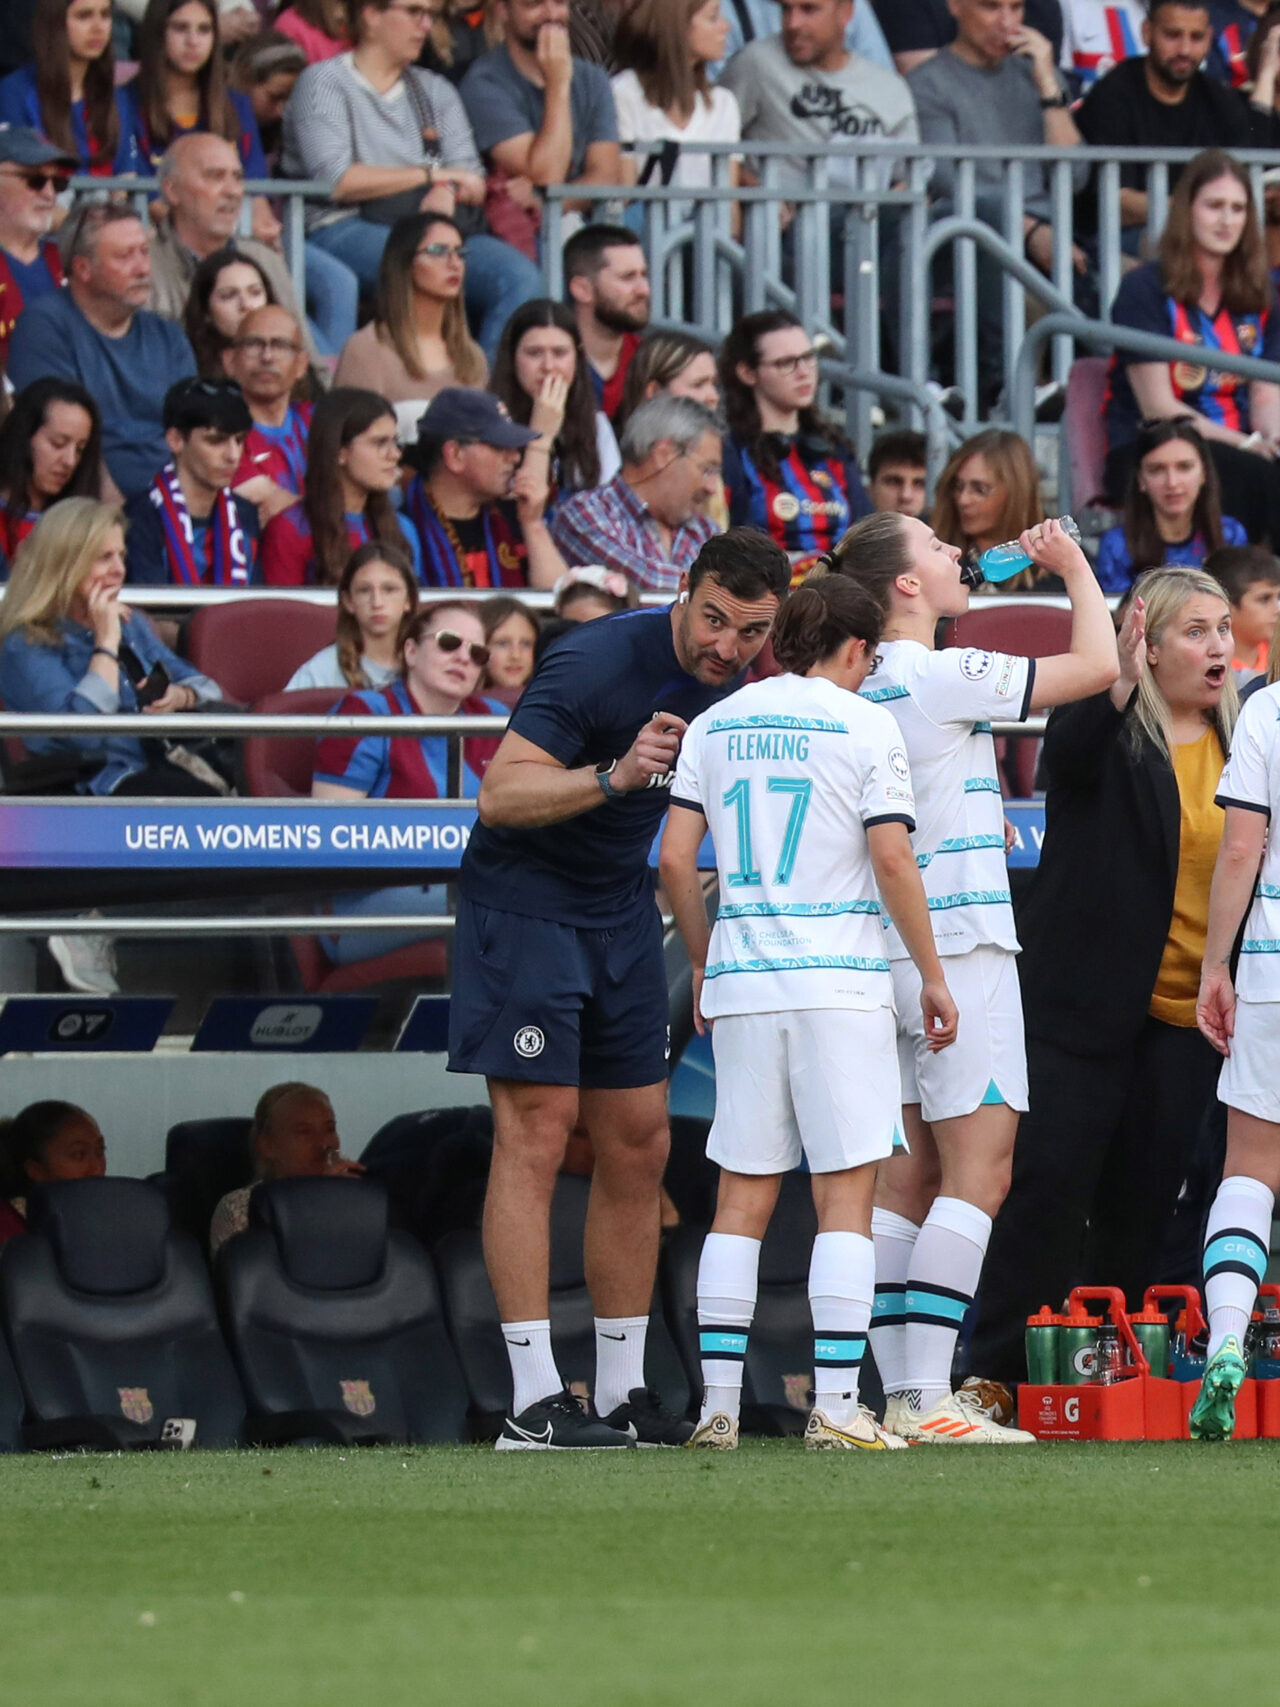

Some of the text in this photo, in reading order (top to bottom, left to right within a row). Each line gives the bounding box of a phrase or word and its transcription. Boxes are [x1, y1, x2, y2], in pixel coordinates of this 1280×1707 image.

[728, 733, 810, 762] FLEMING
[125, 825, 189, 849] UEFA
[196, 824, 321, 849] WOMEN'S
[722, 775, 813, 888] 17
[758, 937, 812, 947] FOUNDATION
[759, 929, 794, 939] CHELSEA
[255, 1026, 311, 1037] HUBLOT
[1223, 1243, 1257, 1259] CFC
[1064, 1397, 1080, 1423] G
